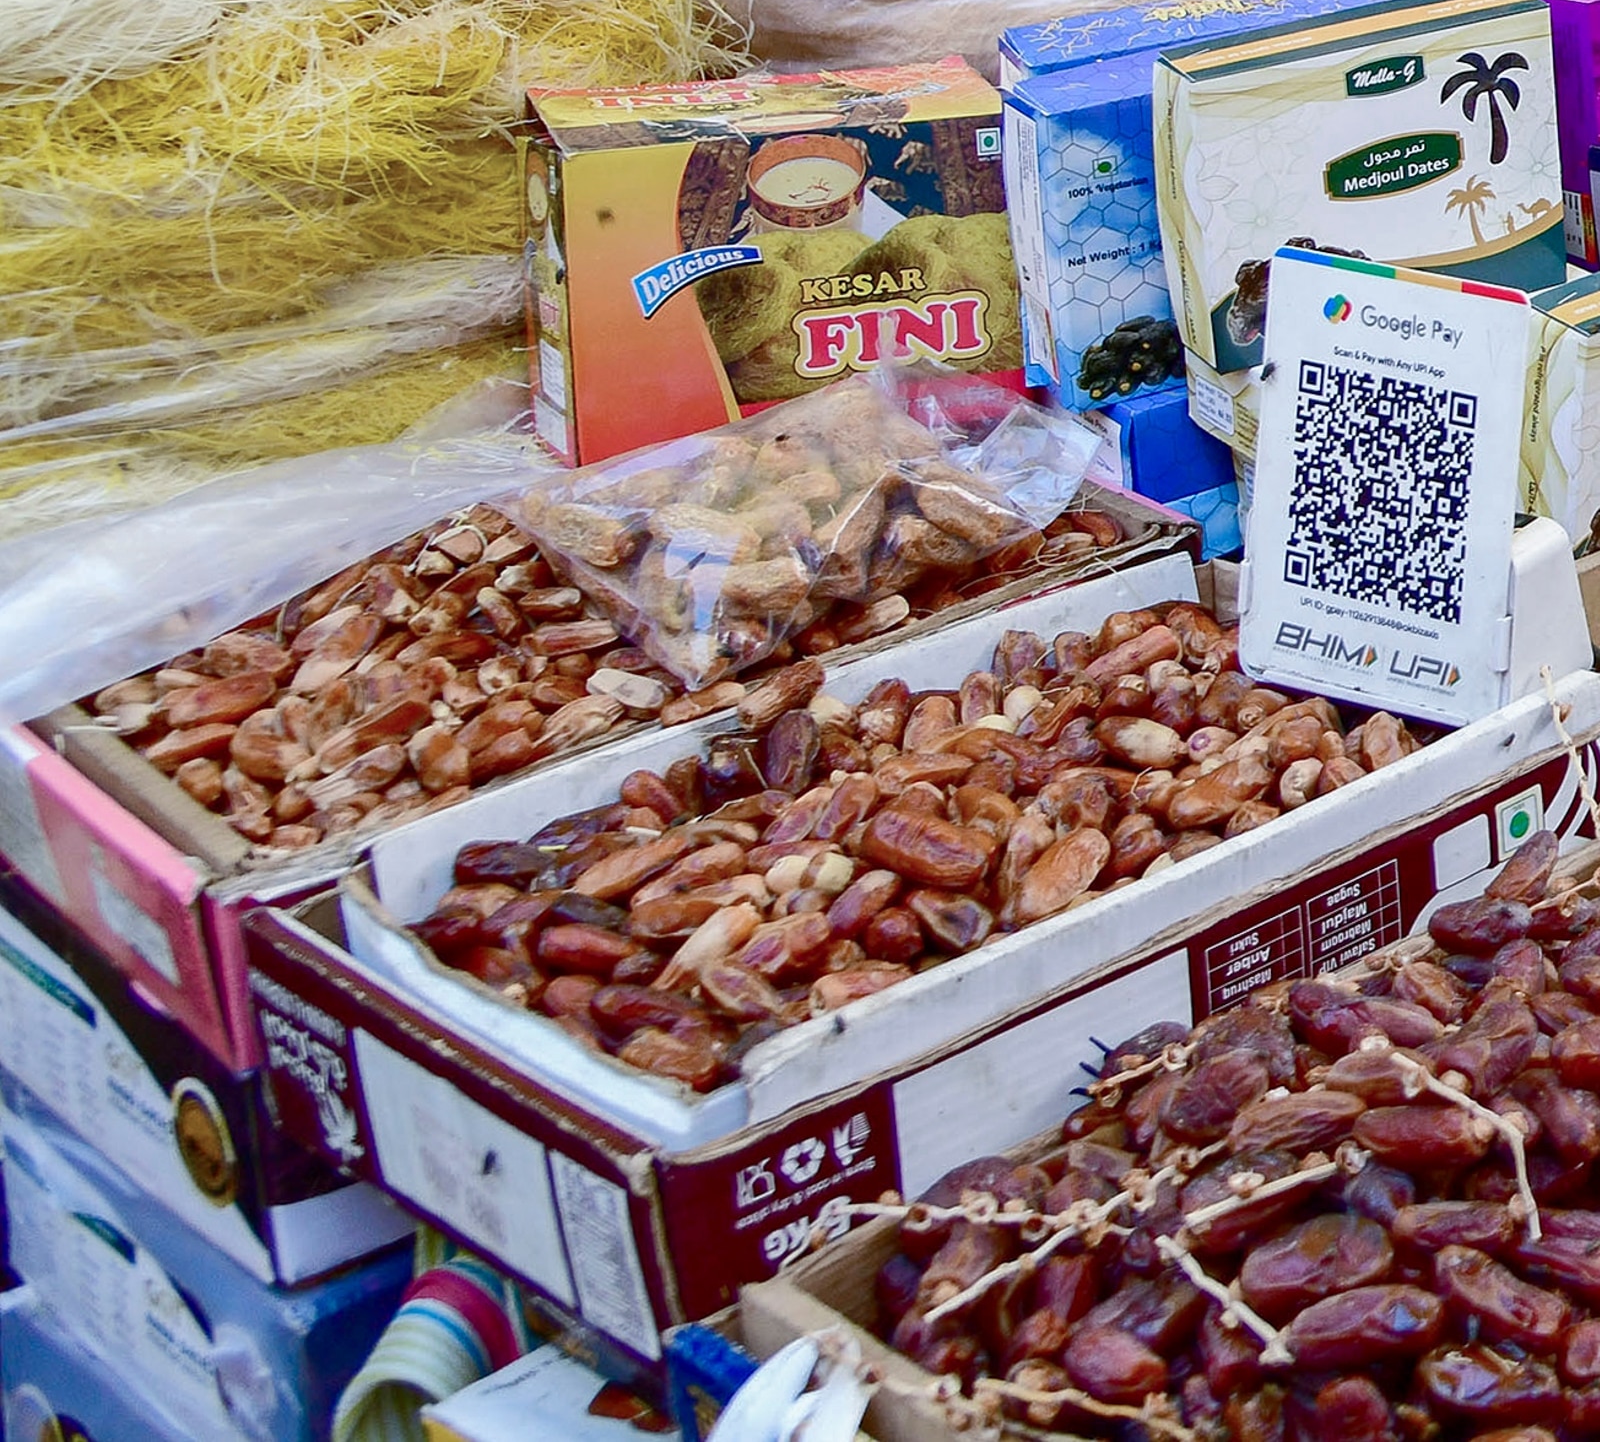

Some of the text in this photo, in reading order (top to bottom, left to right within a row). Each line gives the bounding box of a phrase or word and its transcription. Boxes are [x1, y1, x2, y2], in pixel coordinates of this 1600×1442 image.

[1351, 59, 1416, 91] Mulla-G
[1362, 139, 1425, 168] تمر مجول
[1067, 176, 1148, 199] 100% Vegetarian
[1344, 155, 1450, 193] Medjoul Dates
[1067, 248, 1130, 268] Net Weight
[639, 247, 745, 306] Delicious
[800, 267, 926, 303] KESAR
[802, 299, 985, 370] FINI
[1361, 305, 1463, 350] Google Pay
[1334, 346, 1445, 379] Scan Pay with Any UPI App
[1275, 621, 1450, 686] BHIM UPI
[1327, 884, 1361, 906] Sugae
[1322, 902, 1367, 934] Majdul
[1230, 933, 1259, 956] Sukri
[1321, 919, 1372, 951] Mabroom
[1226, 947, 1270, 976] Anber
[1320, 939, 1376, 973] Safawi VIP
[1223, 969, 1272, 1000] Mashruq
[846, 1156, 876, 1176] Store
[806, 1179, 831, 1198] cool
[773, 1198, 791, 1213] dry
[764, 1216, 809, 1260] KG
